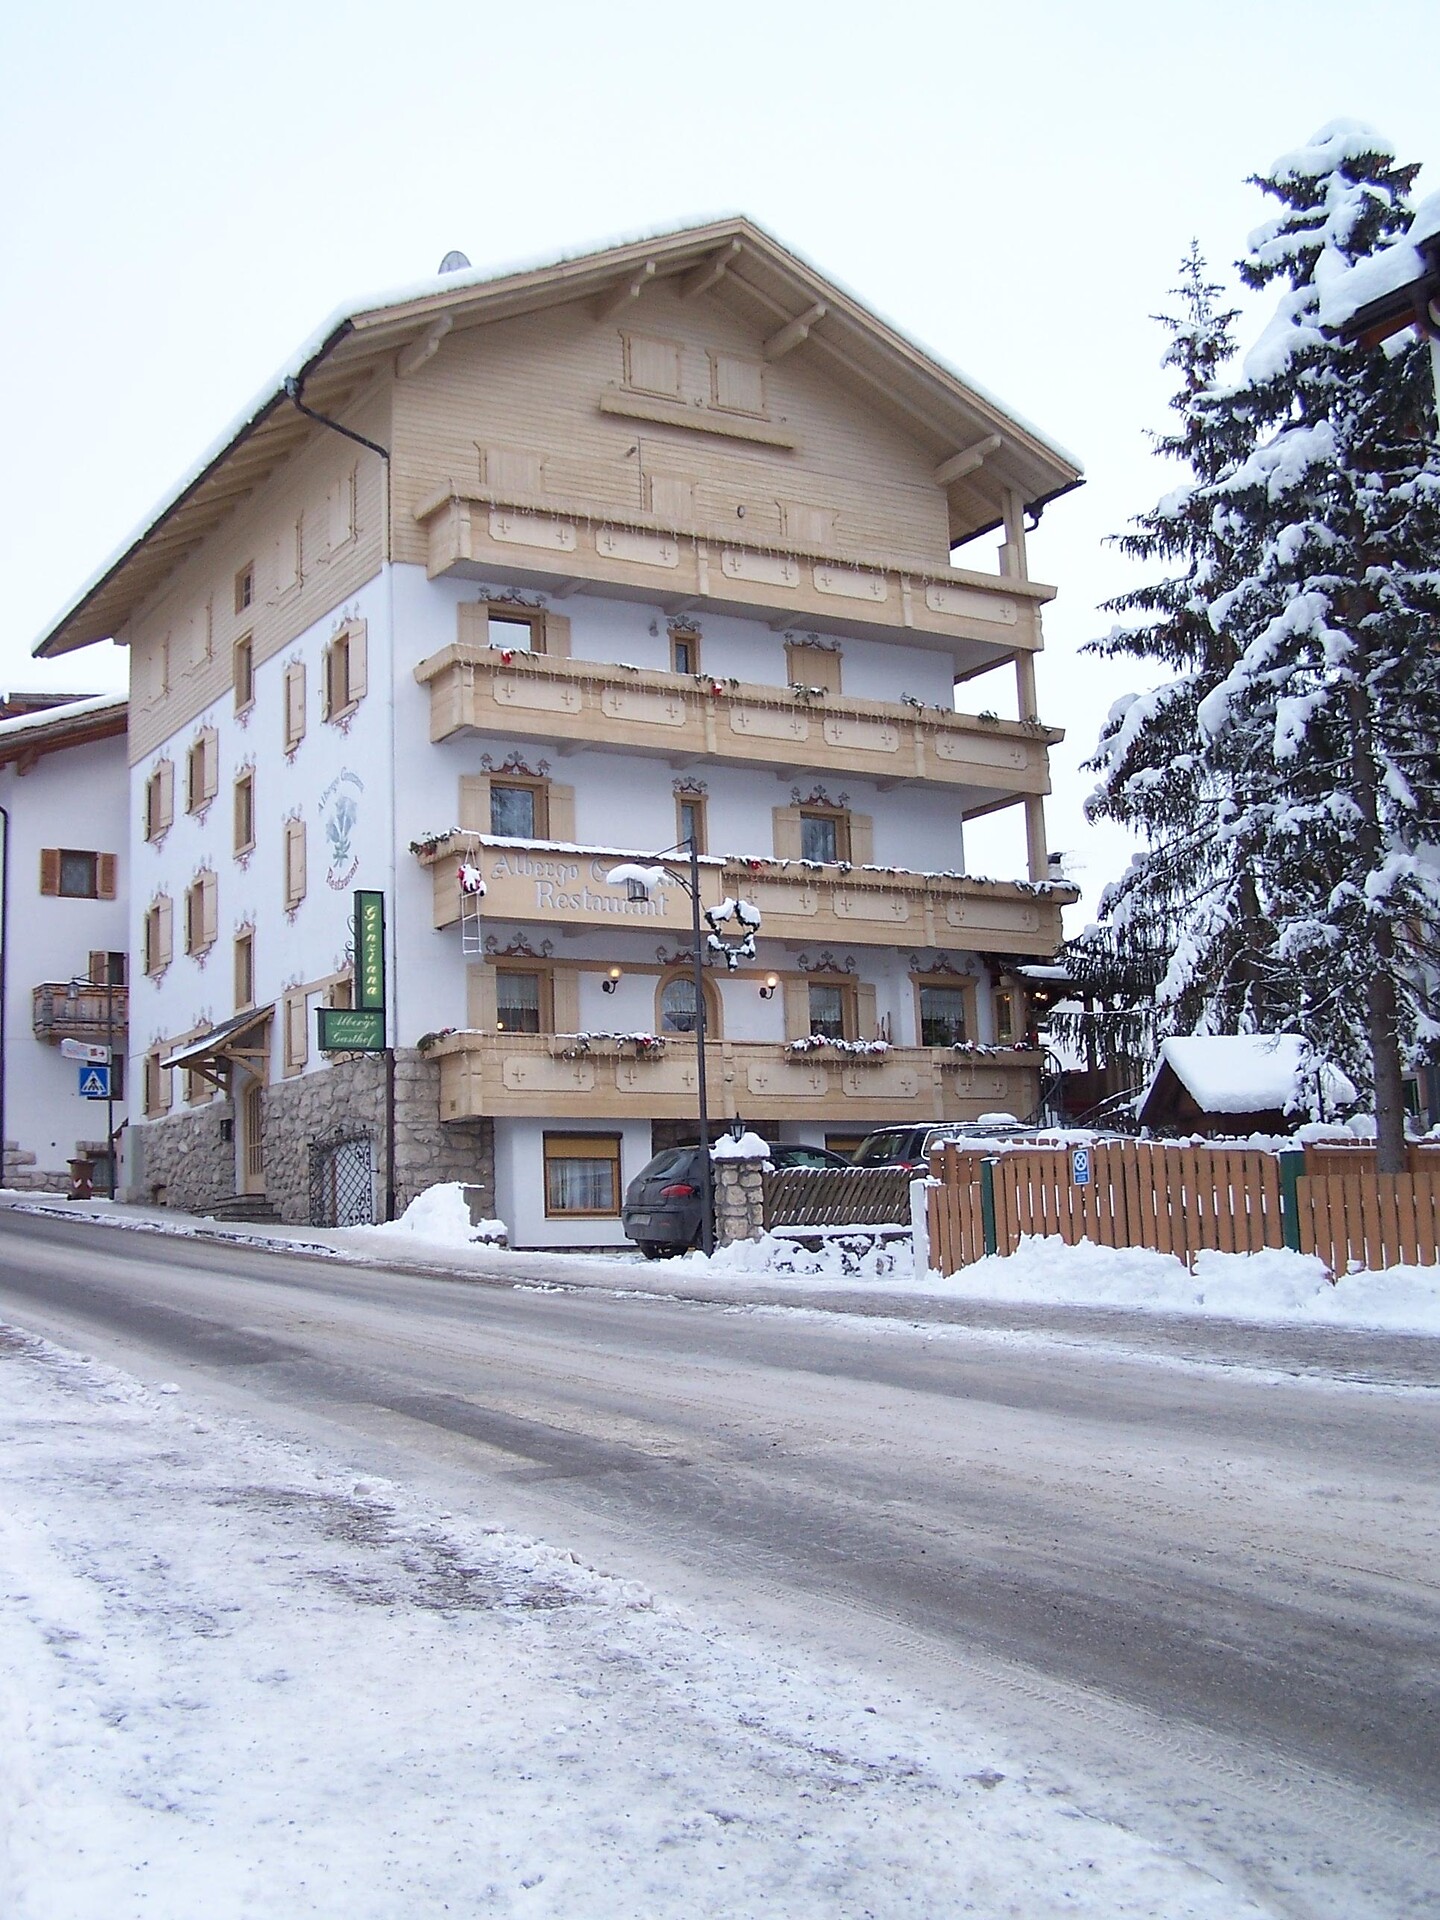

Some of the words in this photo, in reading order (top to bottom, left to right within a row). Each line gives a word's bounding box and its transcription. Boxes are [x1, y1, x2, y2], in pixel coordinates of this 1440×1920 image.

[491, 853, 579, 887] Albergo
[535, 879, 670, 916] Restaurant
[332, 1031, 377, 1047] Gasthof
